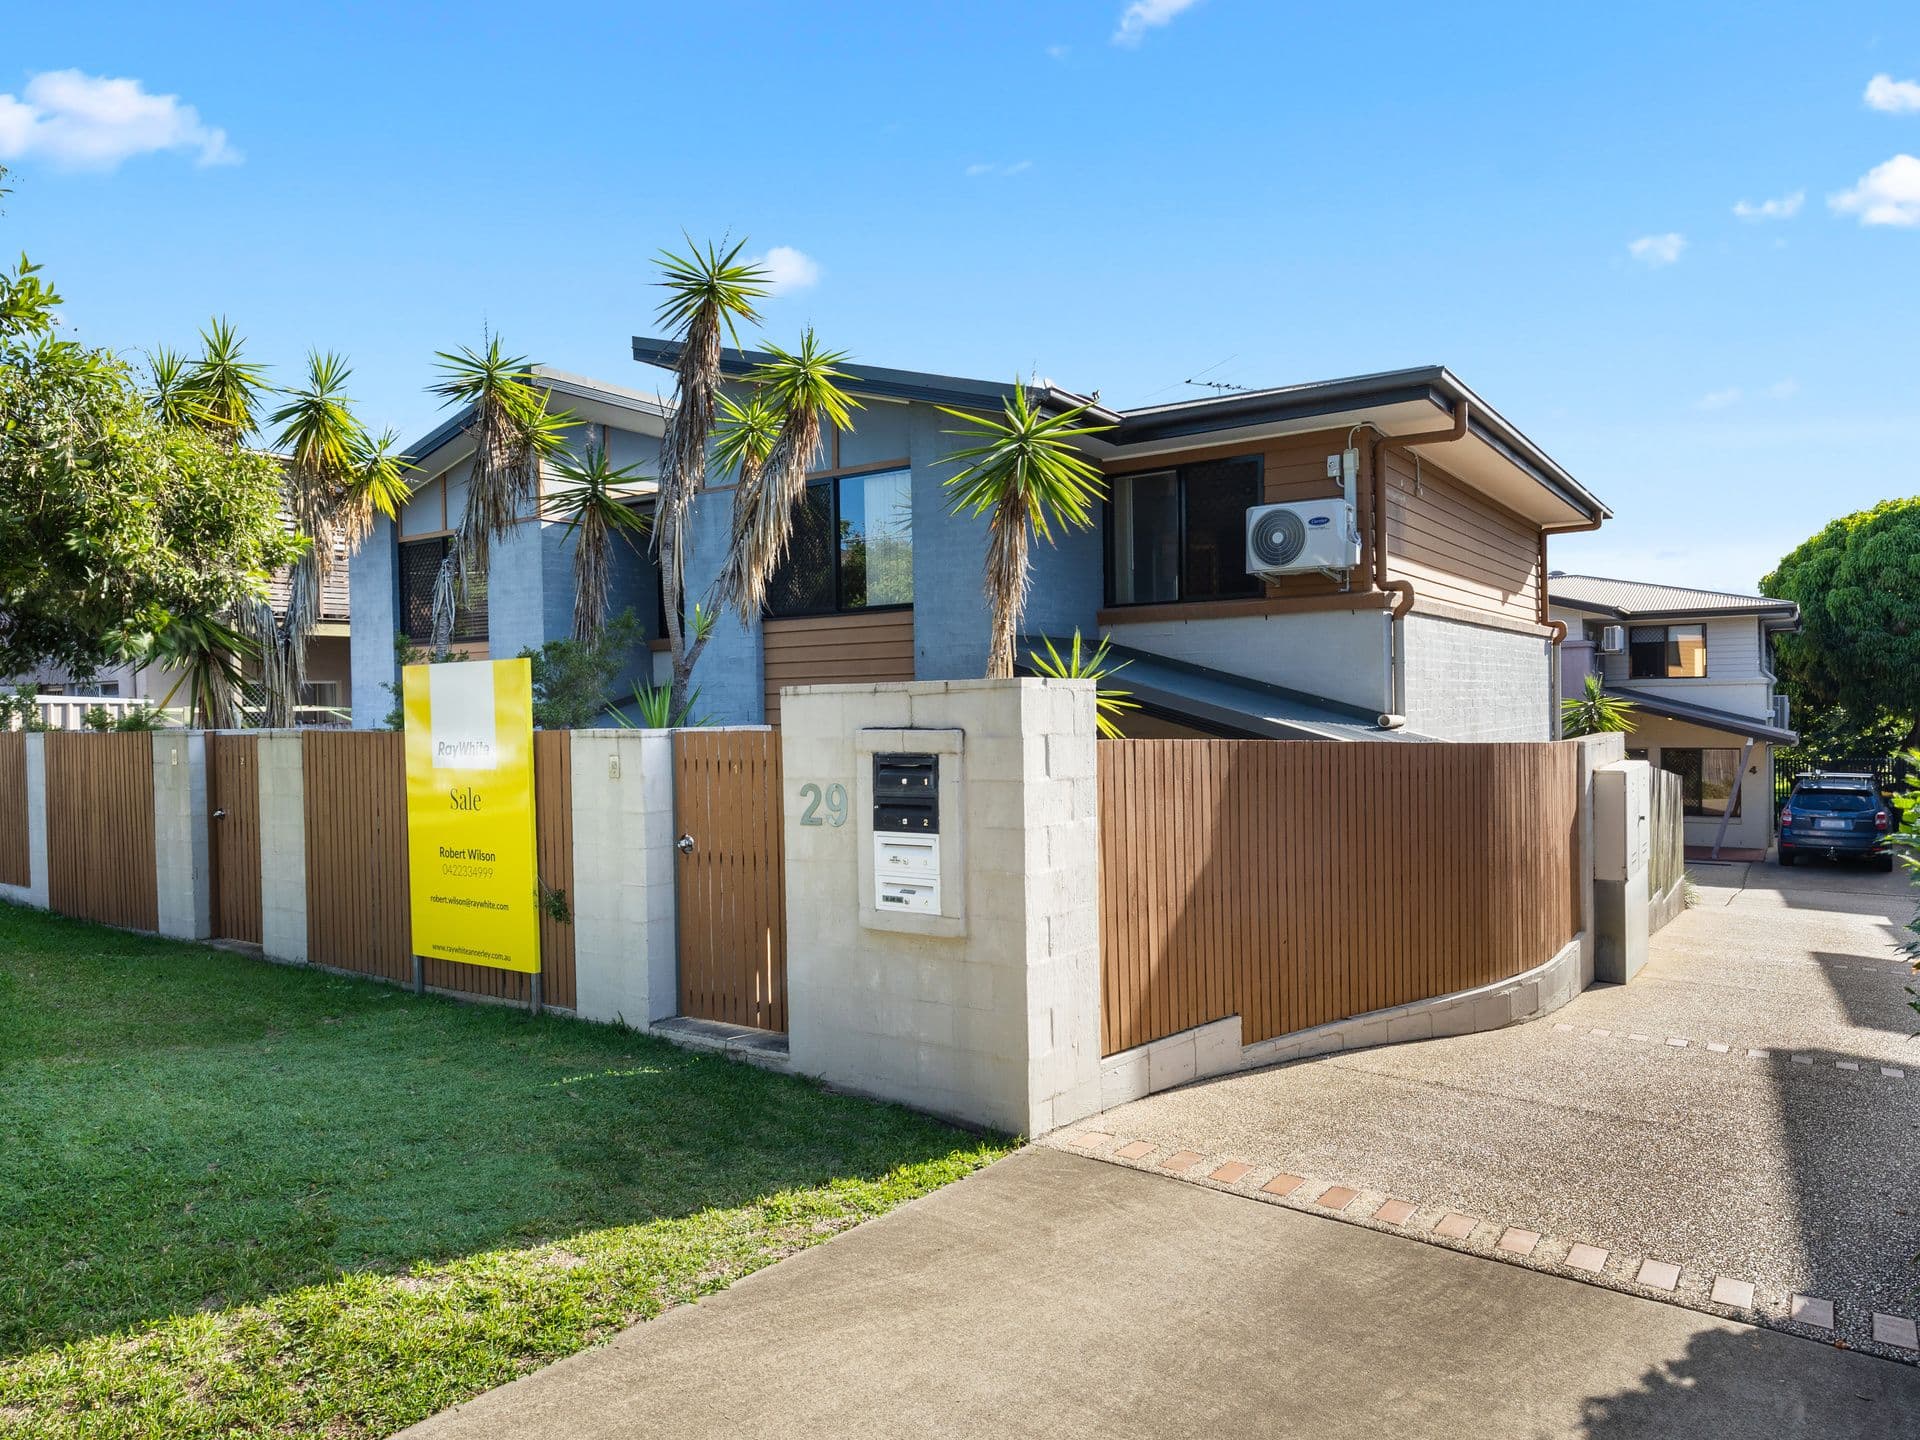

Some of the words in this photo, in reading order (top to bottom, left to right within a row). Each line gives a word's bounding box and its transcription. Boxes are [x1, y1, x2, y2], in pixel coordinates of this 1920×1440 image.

[1749, 765, 1758, 775] 4
[450, 787, 481, 811] Sale
[800, 783, 848, 827] 29
[440, 847, 466, 859] Robert
[467, 849, 496, 862] Wilson
[442, 864, 494, 878] 0422334999
[430, 895, 509, 911] robert.wilson@raywhite.com
